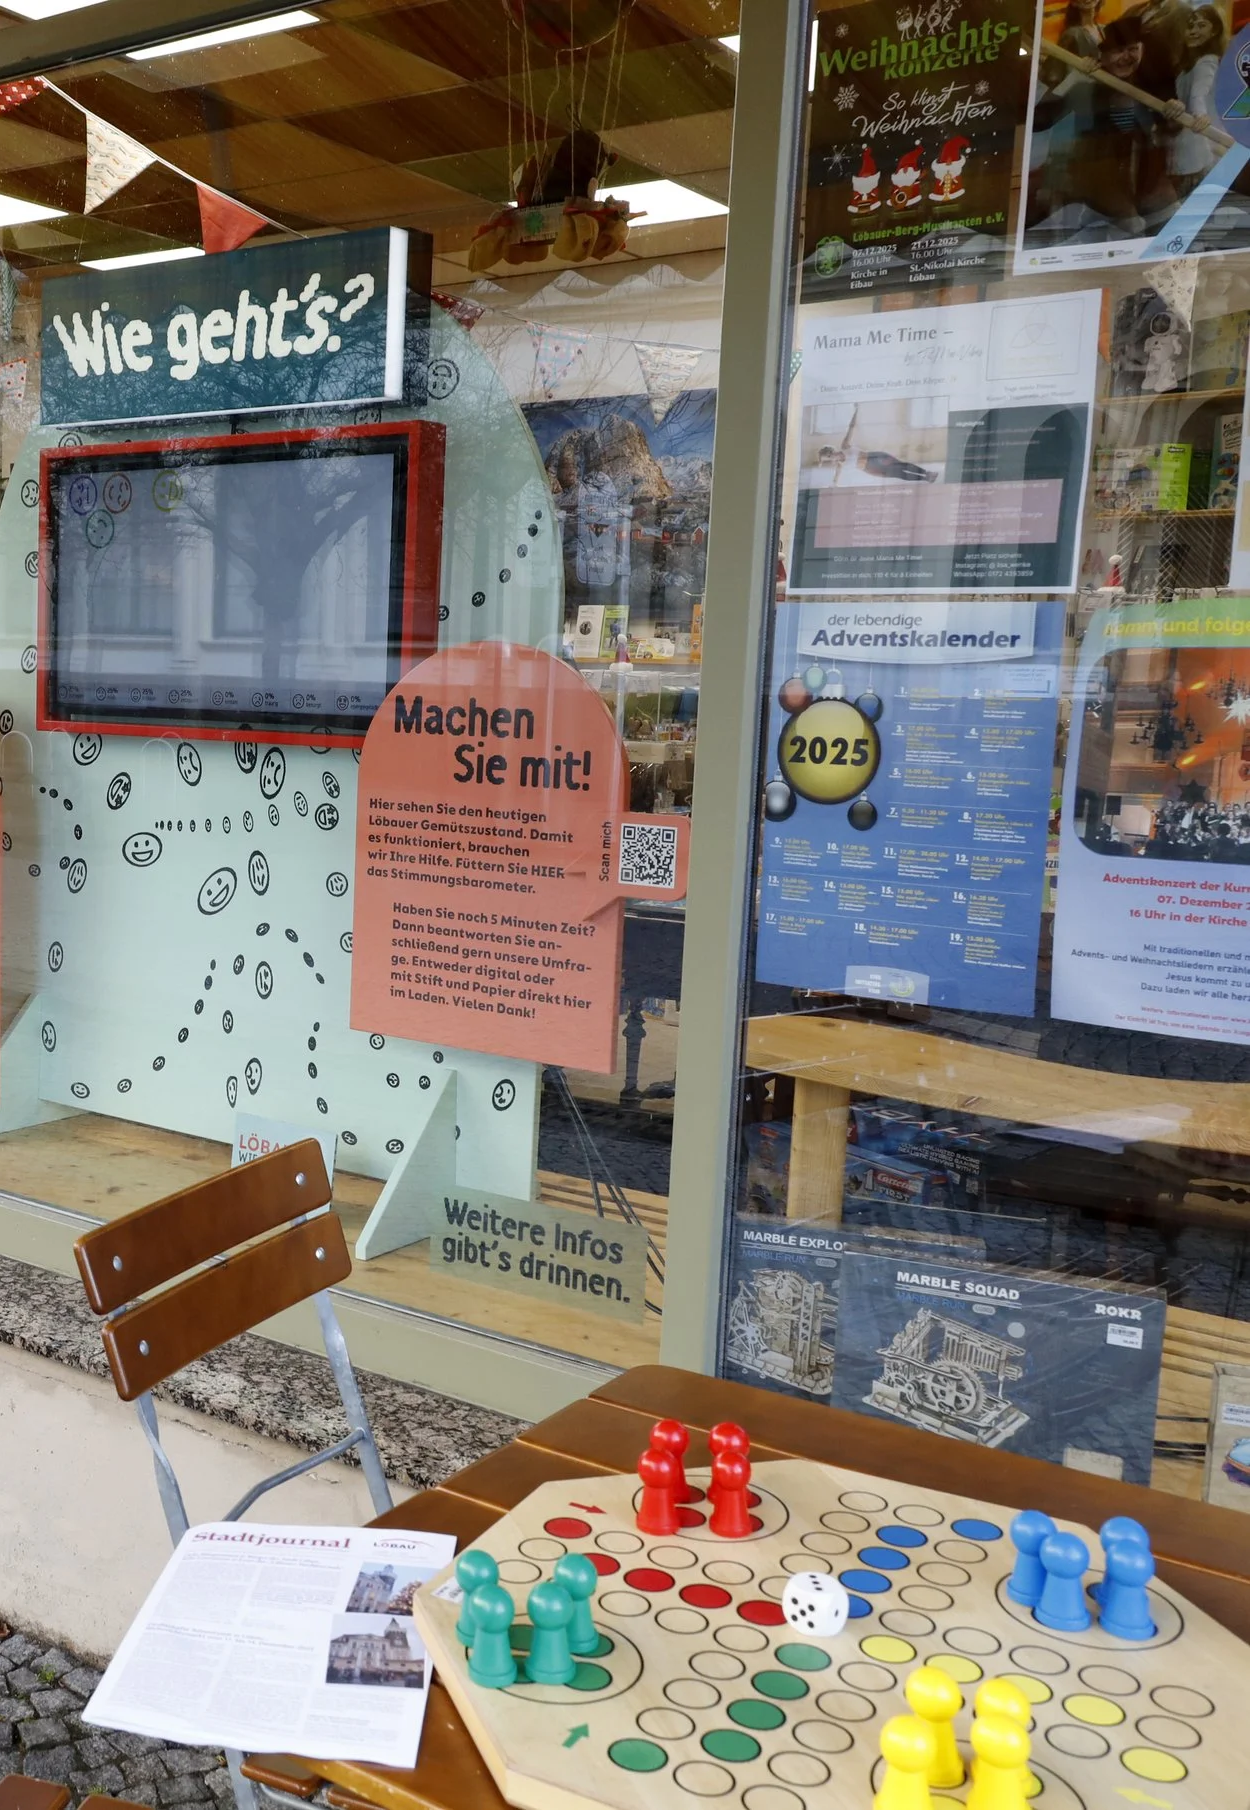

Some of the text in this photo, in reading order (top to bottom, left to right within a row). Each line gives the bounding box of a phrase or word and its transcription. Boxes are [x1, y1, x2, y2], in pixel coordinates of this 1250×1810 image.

[819, 18, 1021, 77] Weihnachts-
[884, 43, 999, 80] konzerte
[883, 81, 970, 116] So klingt
[852, 95, 997, 138] Weihnachten
[986, 212, 1004, 224] e.V.
[852, 244, 897, 257] 07.12.2025
[911, 236, 958, 250] 21.12.2025
[852, 257, 874, 267] 16.00
[911, 250, 934, 259] 16.00
[957, 256, 985, 266] Kirche
[851, 270, 877, 279] Kirche
[851, 280, 873, 289] Eibau
[909, 273, 935, 282] Löbau
[53, 272, 374, 381] Wie geht's?
[814, 327, 937, 349] Mama Me Time
[827, 613, 923, 628] der lebendige
[1163, 619, 1198, 632] und
[811, 629, 1021, 648] Adventskalender
[264, 692, 275, 700] 0%
[394, 695, 534, 739] Machen
[789, 735, 869, 767] 2025
[454, 741, 590, 791] Sie mit!
[370, 799, 546, 824] Hier sehen Sie den heutigen
[369, 815, 573, 843] Löbauer Gemütszustand. Damit
[368, 834, 529, 857] es funktioniert, brauchen
[599, 821, 612, 882] Scan mich
[368, 849, 565, 879] wir Ihre Hilfe. Füttern Sie HIER
[367, 866, 535, 894] das Stimmungsbarometer.
[1103, 873, 1221, 891] Adventskonzert der
[1157, 895, 1242, 910] 07. Dezember
[393, 903, 596, 937] Haben Sie noch 5 Minuten Zeit?
[1129, 909, 1247, 927] 16 Uhr in der Kirche
[393, 920, 562, 950] Dann beantworten Sie an-
[392, 937, 592, 973] schließend gern unsere Umfra-
[1071, 949, 1214, 972] Advents- und Weihnachtsliedern
[1159, 945, 1242, 961] traditionellen und
[391, 955, 555, 986] ge. Entweder digital oder
[1165, 972, 1228, 987] Jesus kommt
[390, 970, 592, 1010] mit Stift und Papier direkt hier
[1140, 982, 1229, 1000] Dazu laden alle
[390, 986, 535, 1019] im Laden. Vielen Dank!
[443, 1197, 624, 1266] Weitere Infos
[743, 1230, 847, 1251] MARBLE EXPLO
[742, 1248, 806, 1264] MARBLE RUN
[519, 1254, 630, 1304] drinnen.
[897, 1271, 1020, 1300] MARBLE SQUAD
[1095, 1303, 1142, 1321] ROKR
[192, 1530, 350, 1549] Stadtjournal
